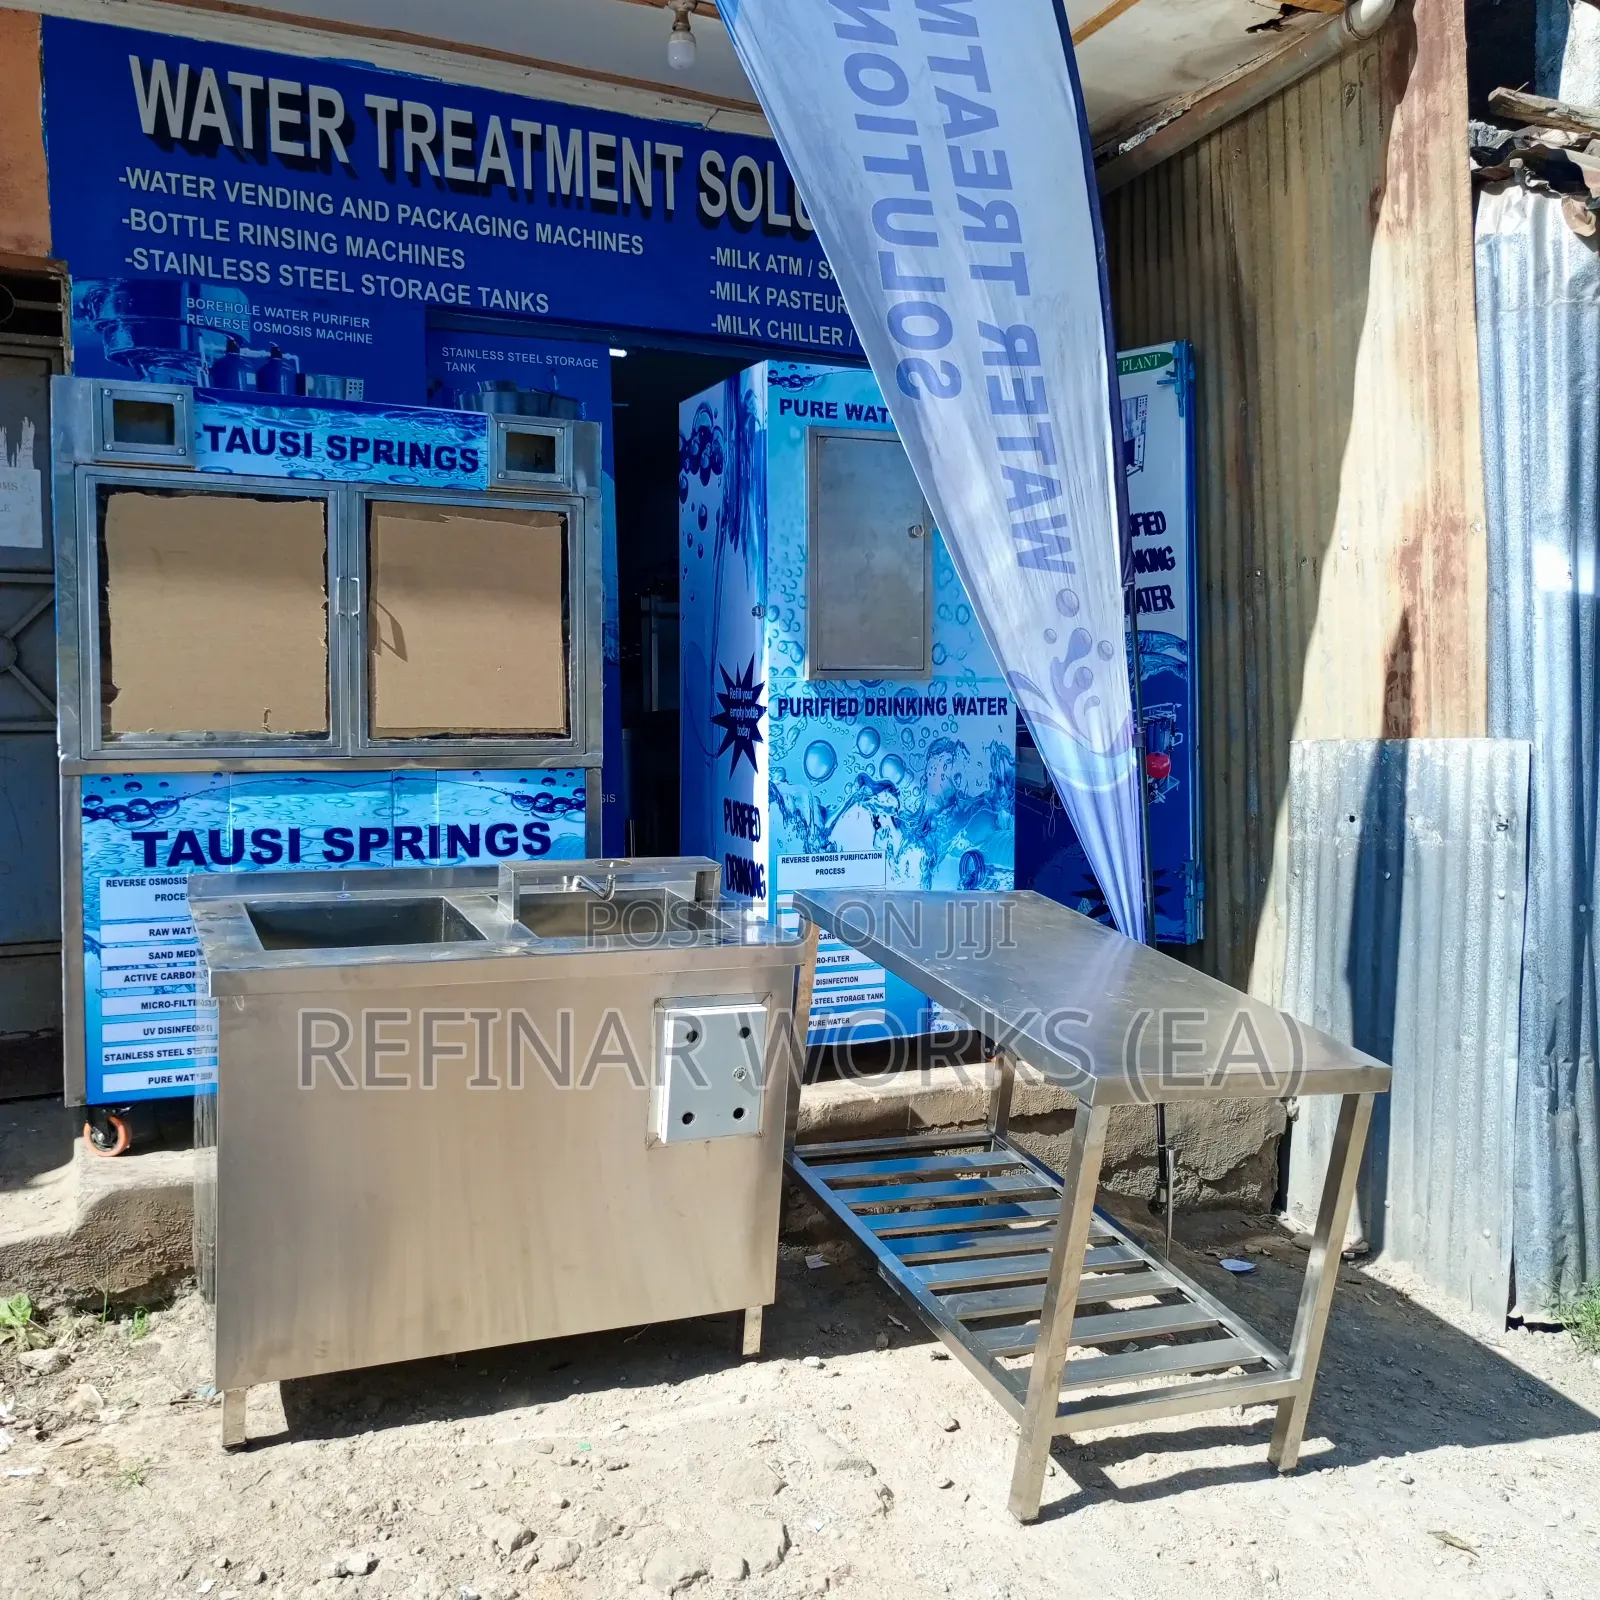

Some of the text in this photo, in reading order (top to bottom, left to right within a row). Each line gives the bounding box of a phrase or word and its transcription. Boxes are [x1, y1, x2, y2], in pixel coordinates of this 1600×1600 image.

[129, 54, 350, 164] WATER
[364, 94, 684, 212] TREATMENT
[119, 166, 644, 256] -WATER VENDING AND PACKAGING MACHINES
[121, 208, 466, 270] -BOTTLE RINSING MACHINES
[711, 247, 760, 271] -MILK
[765, 254, 803, 276] ATM
[807, 259, 813, 277] /
[125, 248, 549, 313] -STAINLESS STEEL STORAGE TANKS
[710, 280, 760, 305] -MILK
[186, 297, 370, 328] BOREHOLE WATER PURIFIER
[186, 313, 373, 344] REVERSE OSMOSIS MACHINE
[711, 314, 761, 337] -MILK
[767, 320, 843, 346] CHILLER
[442, 347, 599, 369] STAINLESS STEEL STORAGE
[1122, 353, 1161, 372] PLANT
[445, 361, 476, 373] TANK
[779, 398, 894, 424] PURE WAT
[203, 424, 479, 473] TAUSI SPRINGS
[729, 687, 753, 703] Refill your
[730, 706, 759, 721] empty bottle
[777, 696, 1008, 718] PURIFIED DRINKING WATER
[737, 724, 751, 739] today
[723, 797, 761, 842] PURIFIED
[132, 821, 552, 868] TAUSI SPRINGS
[782, 853, 882, 864] REVERSE OSMOSIS PURIFICATION
[725, 852, 767, 901] DRINKING
[815, 868, 845, 876] PROCESS
[106, 877, 188, 888] REVERSE OSMOSIS
[155, 893, 188, 902] PROCE
[149, 928, 170, 937] RAW
[149, 951, 174, 960] SAND
[124, 973, 158, 983] ACTIVE
[816, 976, 859, 985] DISINFECTION
[814, 997, 834, 1005] STEEL
[836, 994, 866, 1003] STORAGE
[827, 1017, 850, 1026] WATER
[143, 1027, 155, 1036] UV
[104, 1051, 154, 1062] STAINLESS
[157, 1049, 184, 1058] STEEL
[148, 1076, 172, 1085] PURE
